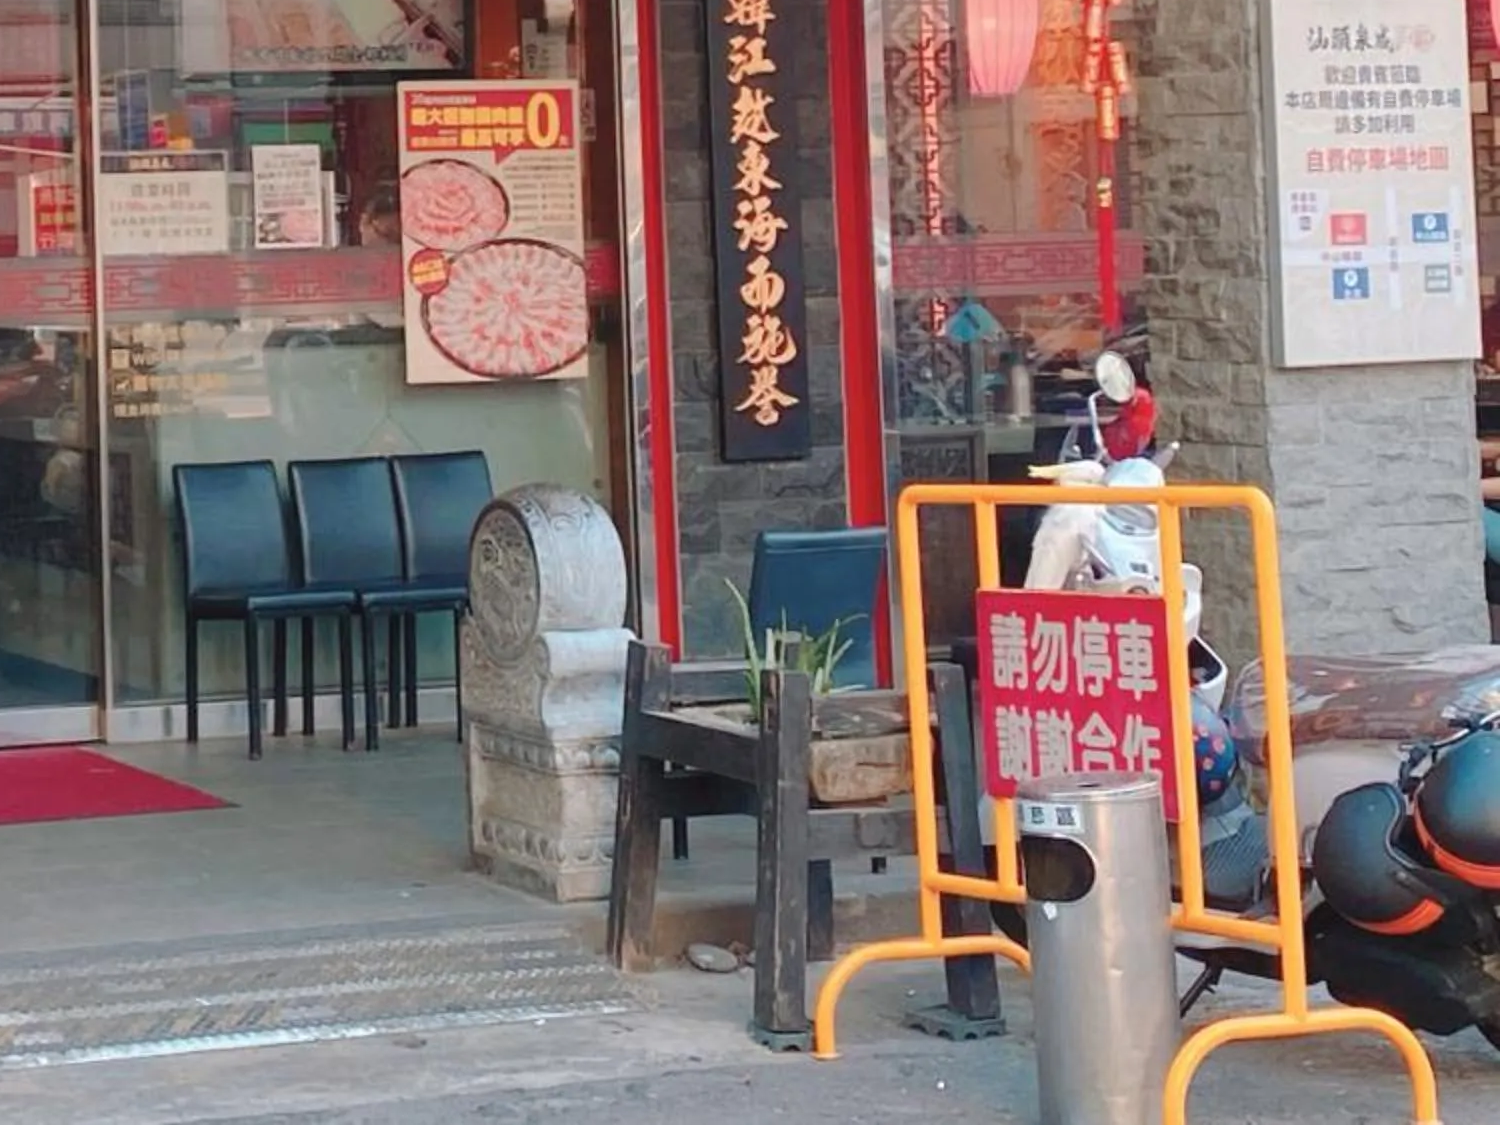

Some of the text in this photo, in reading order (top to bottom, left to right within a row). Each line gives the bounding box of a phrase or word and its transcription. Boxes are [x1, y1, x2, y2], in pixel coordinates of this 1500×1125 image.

[989, 611, 1158, 702] 請勿停車
[995, 704, 1162, 782] 謝謝合作
